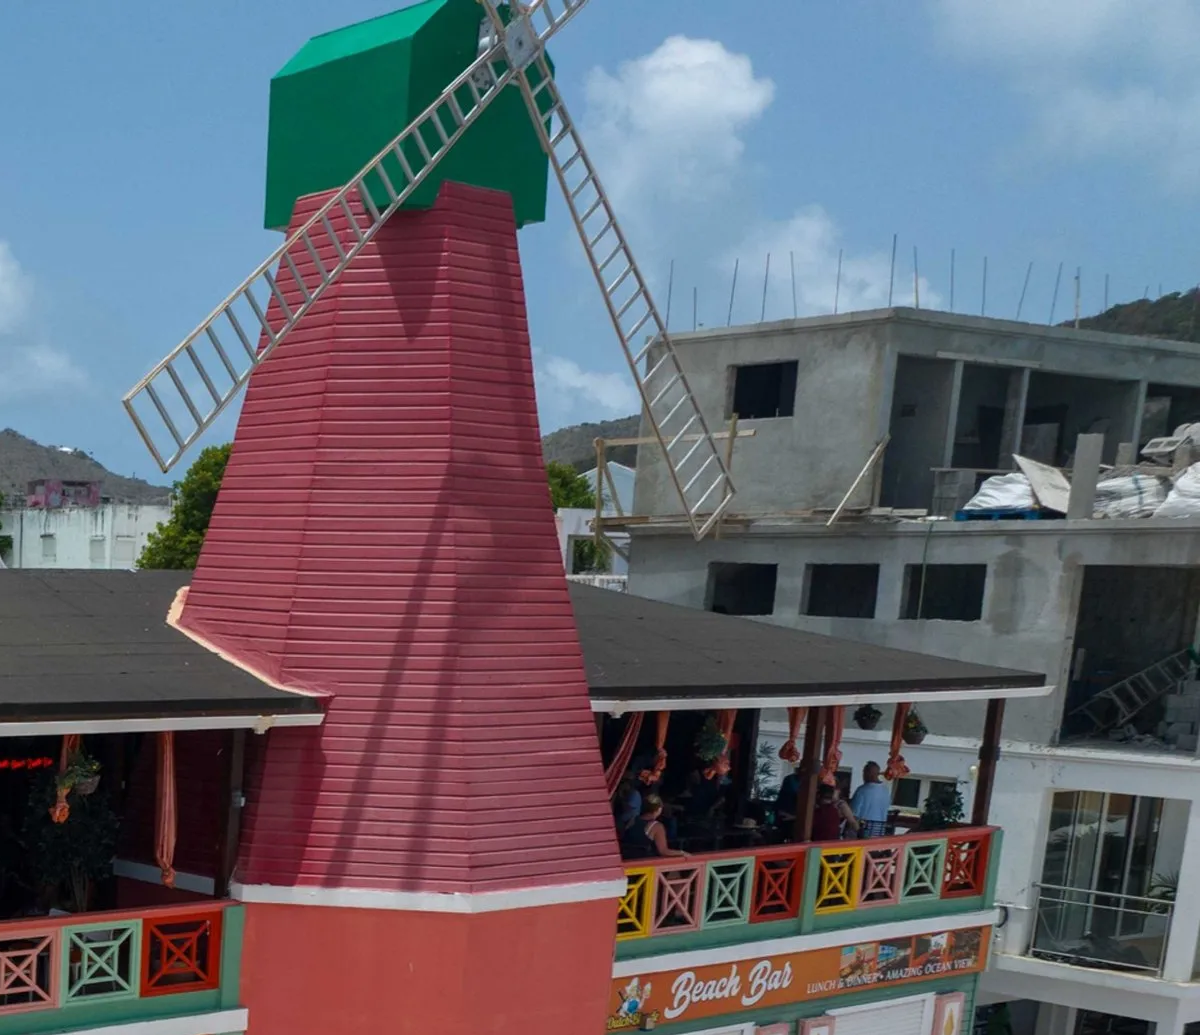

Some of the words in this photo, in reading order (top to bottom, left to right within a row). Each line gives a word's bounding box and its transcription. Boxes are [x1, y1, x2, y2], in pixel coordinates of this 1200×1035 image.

[664, 965, 743, 1019] Beach
[741, 960, 793, 1005] Bar
[806, 981, 836, 995] LUNCH
[846, 974, 880, 989] DINNER
[886, 966, 922, 980] AMAZING
[924, 962, 953, 975] OCEAN
